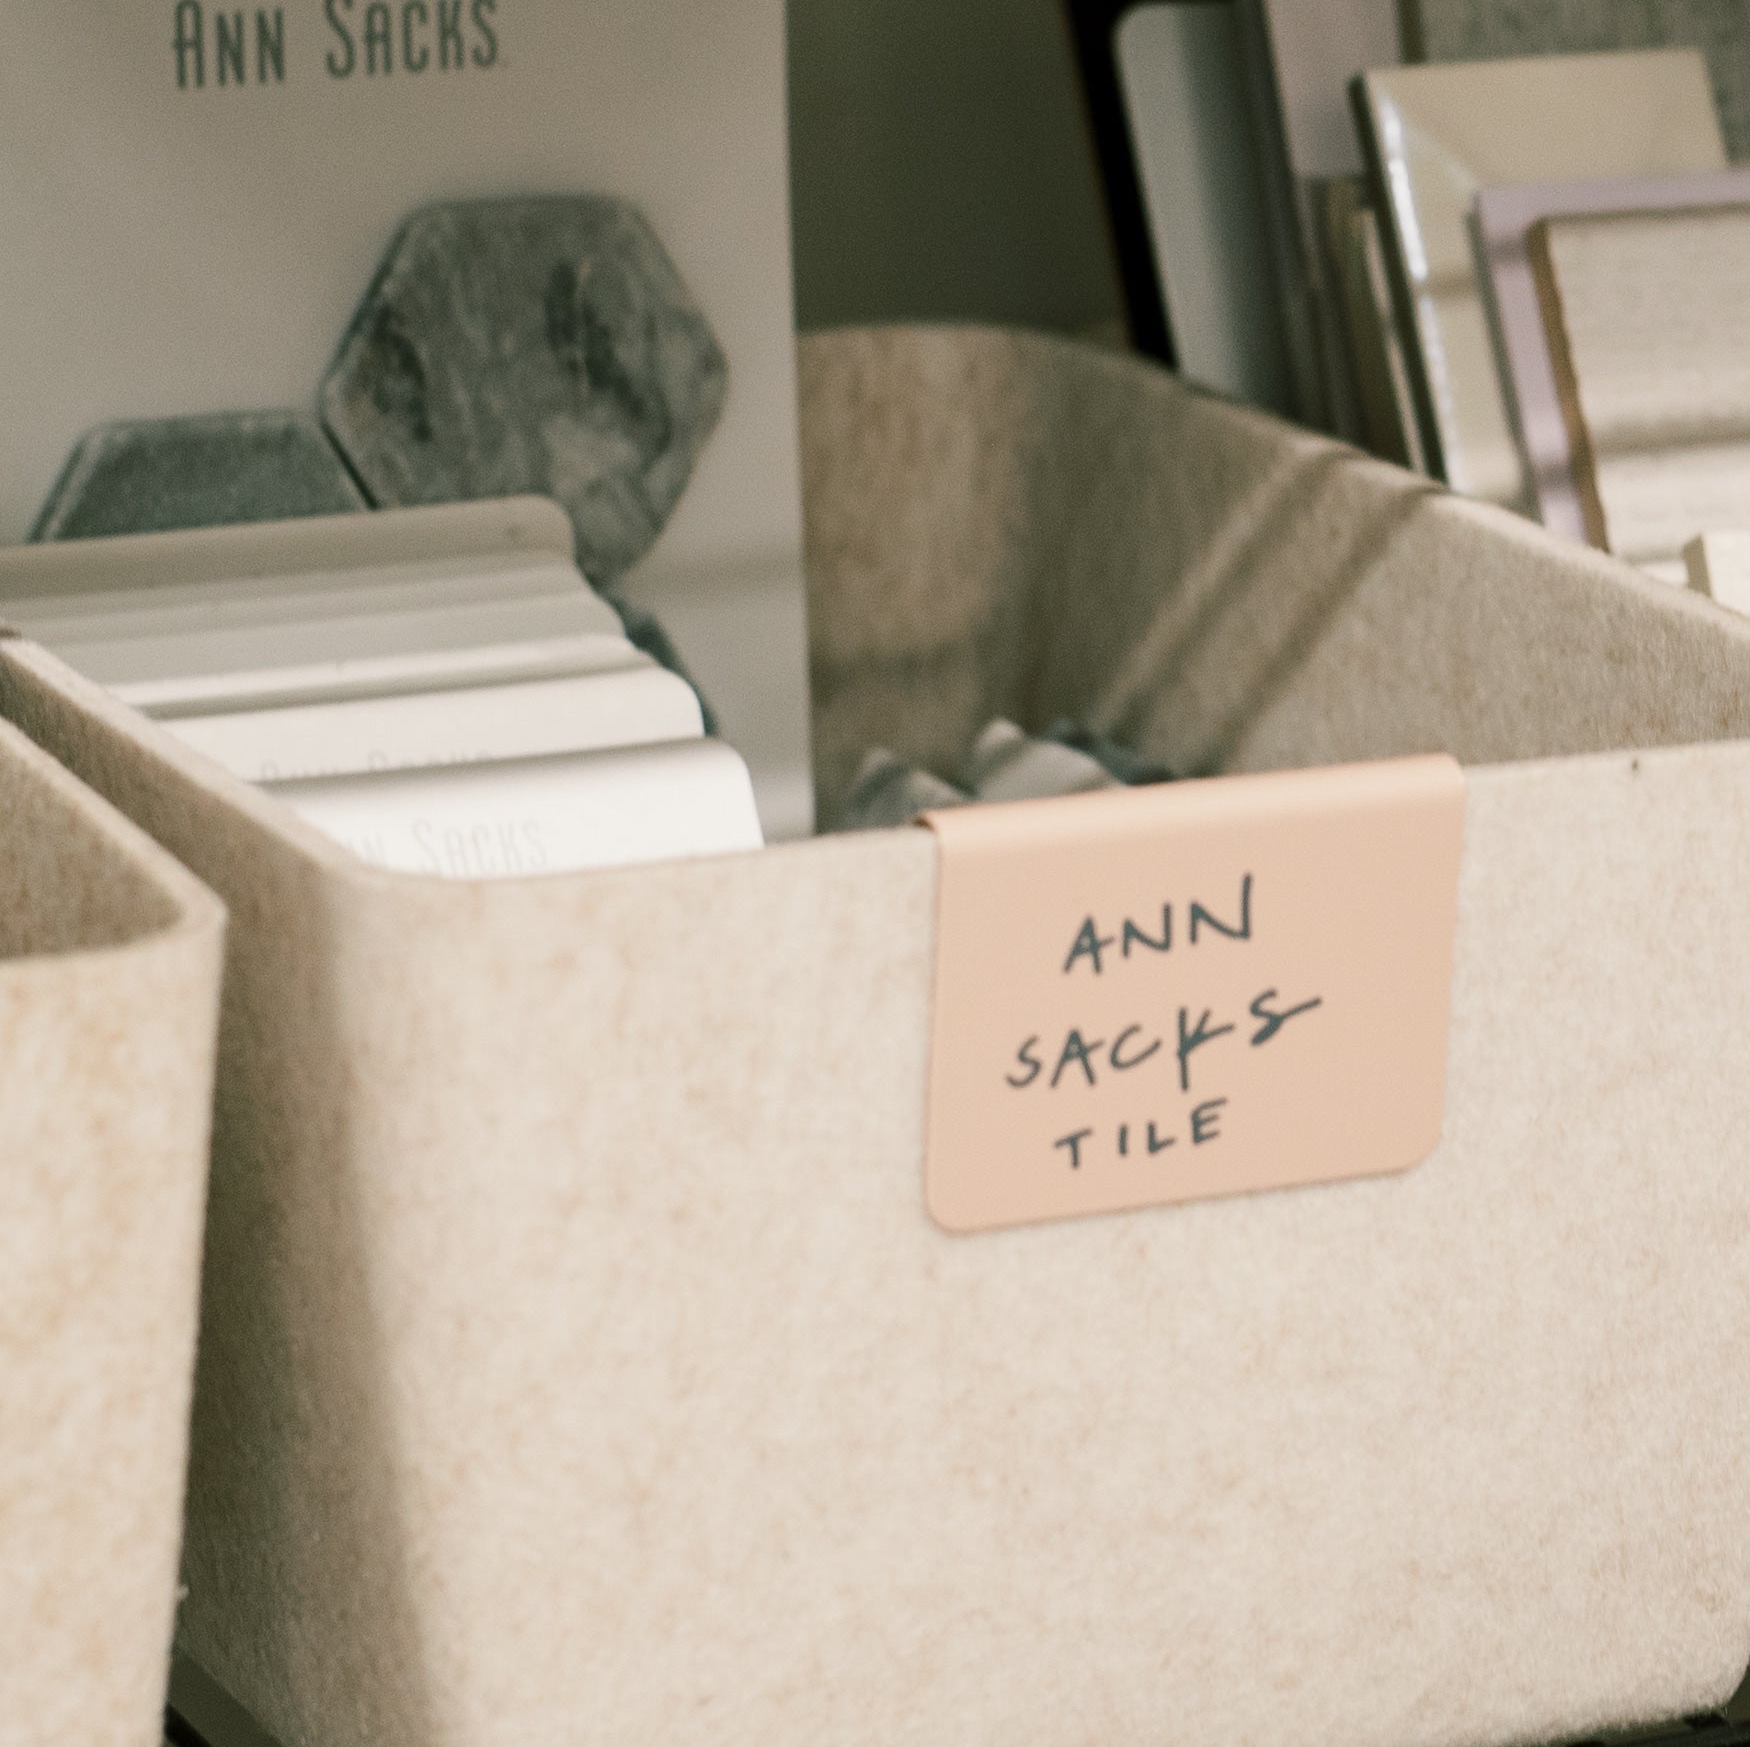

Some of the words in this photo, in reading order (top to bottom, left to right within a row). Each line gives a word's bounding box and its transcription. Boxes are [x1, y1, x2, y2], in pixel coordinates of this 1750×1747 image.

[1062, 872, 1253, 975] ANN
[1005, 988, 1323, 1092] SACKS
[1054, 1097, 1228, 1169] TILE
